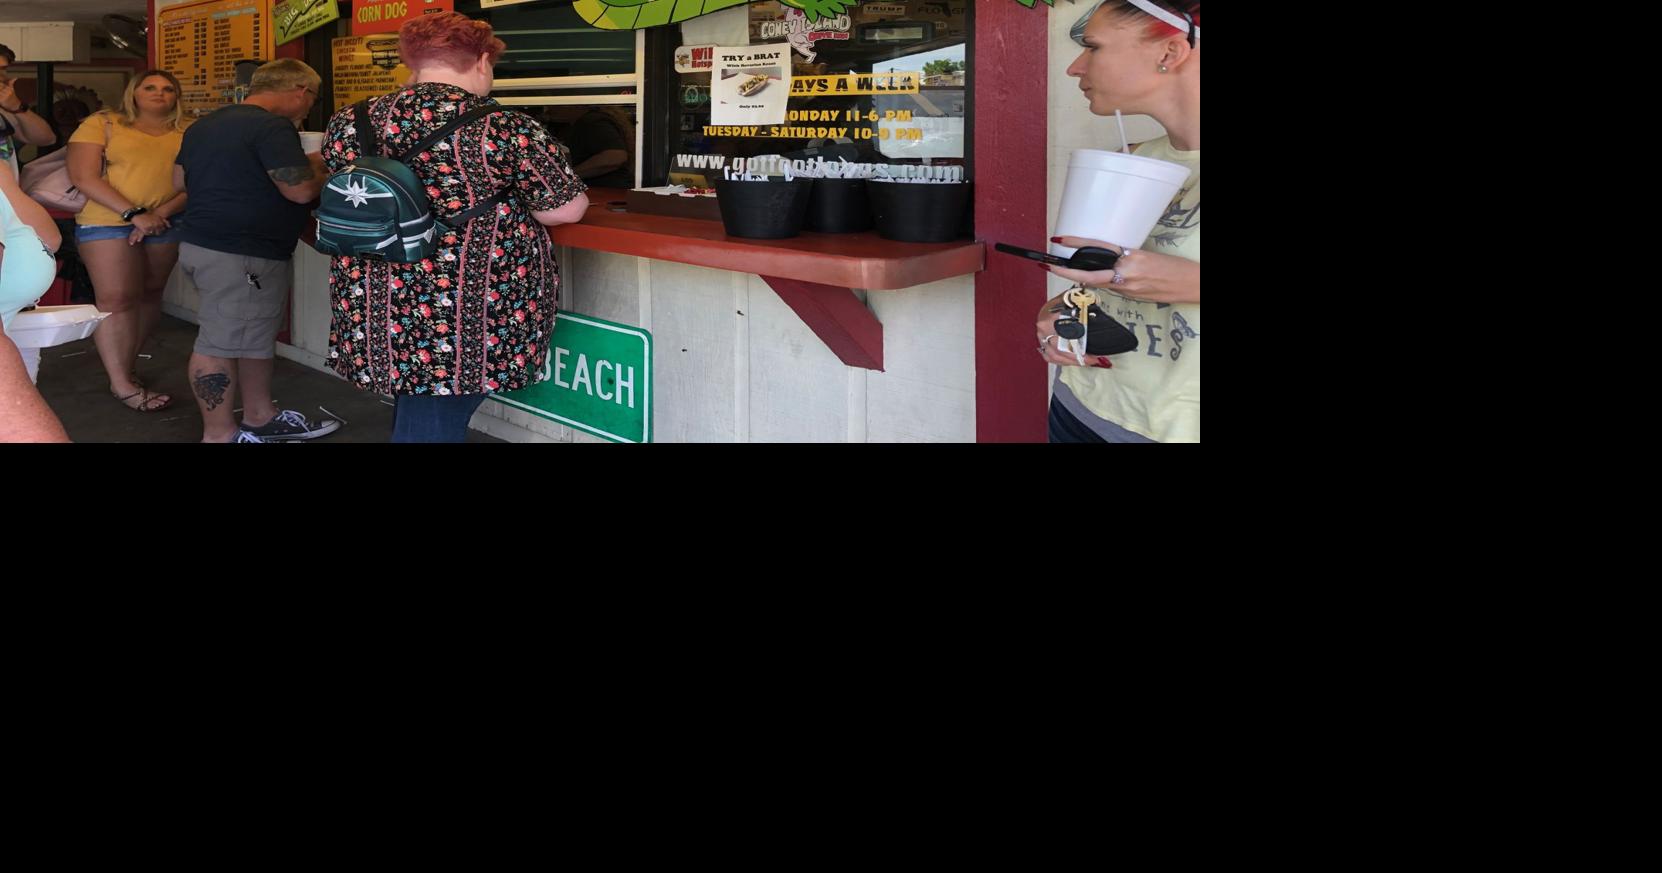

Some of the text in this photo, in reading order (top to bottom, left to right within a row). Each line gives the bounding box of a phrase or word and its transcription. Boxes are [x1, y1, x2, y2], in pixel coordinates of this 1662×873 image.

[358, 2, 407, 23] CORN DOG
[761, 20, 797, 39] CONEY
[754, 52, 780, 60] BRAT
[791, 78, 828, 92] AYS
[835, 78, 848, 91] A
[846, 110, 879, 121] 11-6
[885, 110, 912, 121] PM
[703, 125, 758, 137] TUESDAY
[771, 127, 847, 139] SATURDAY
[895, 128, 922, 139] PM
[1117, 308, 1143, 321] with
